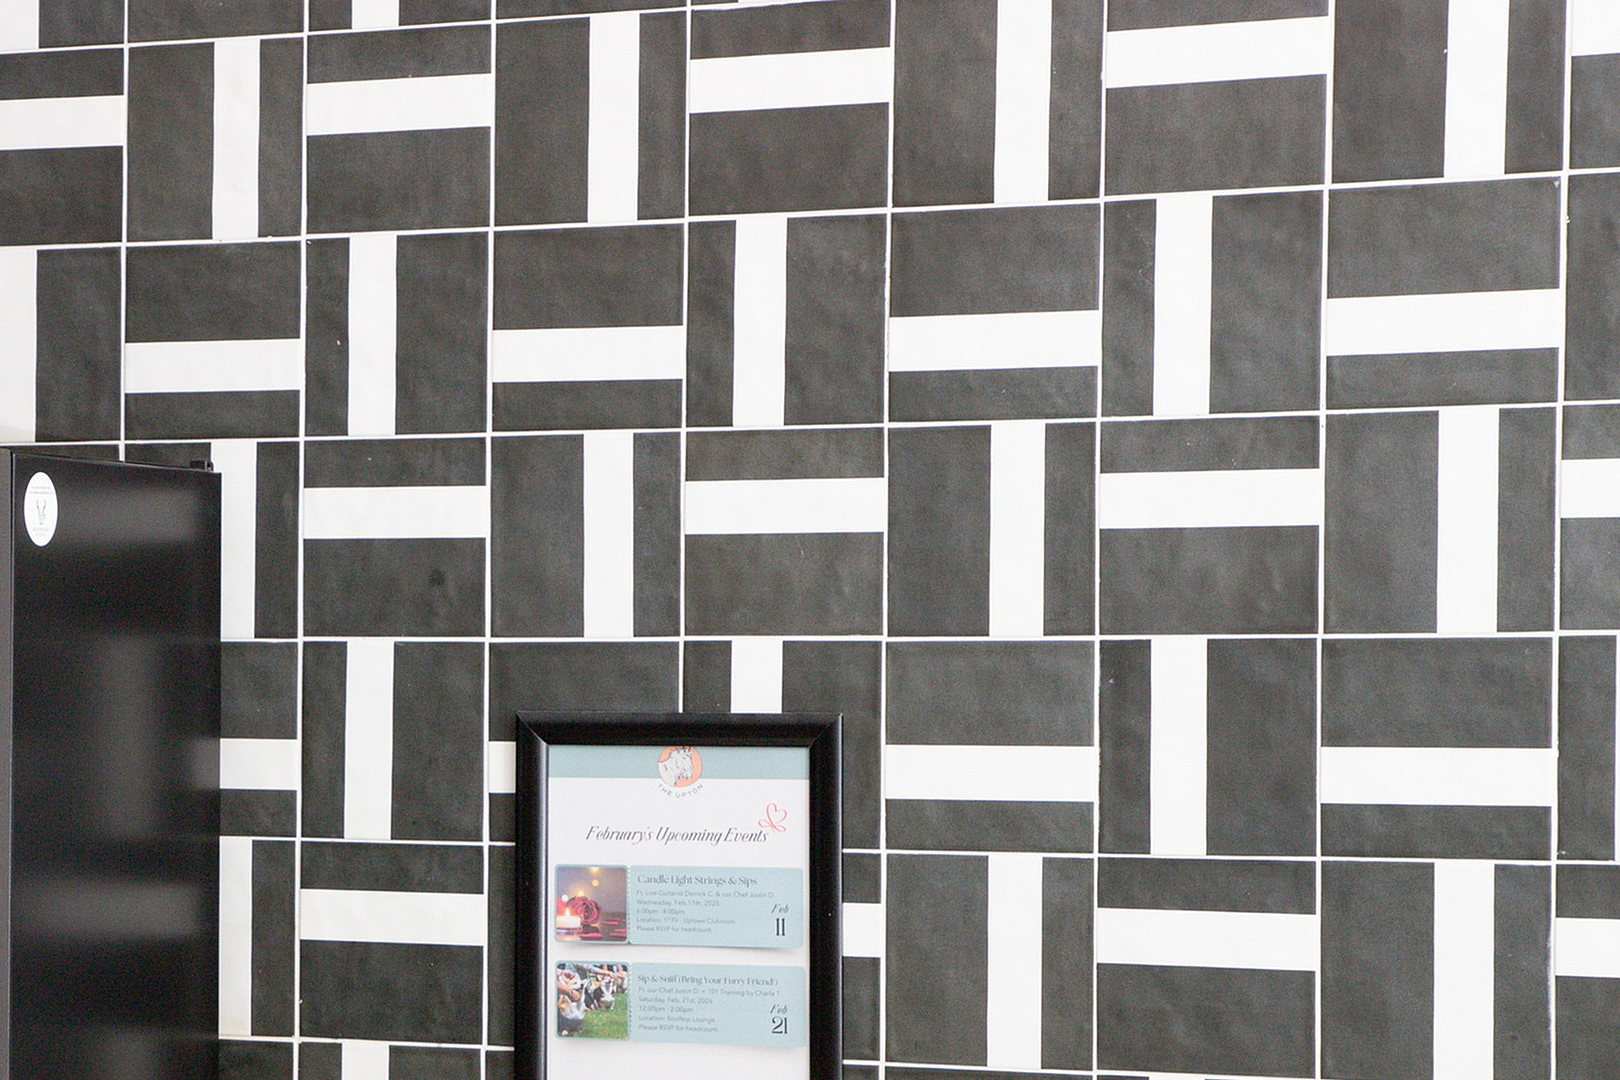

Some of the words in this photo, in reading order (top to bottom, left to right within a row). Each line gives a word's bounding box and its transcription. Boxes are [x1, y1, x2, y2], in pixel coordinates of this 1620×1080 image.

[658, 783, 672, 797] THE
[675, 783, 703, 799] UPTON
[586, 826, 654, 846] February's
[655, 827, 723, 846] Upcoming
[723, 827, 770, 844] Events
[637, 874, 670, 885] Candle
[670, 874, 693, 887] Light
[694, 875, 727, 888] Strings
[728, 876, 737, 886] &
[738, 876, 758, 889] Sips
[771, 903, 790, 914] Feb
[775, 917, 786, 937] 11
[637, 975, 650, 984] Sip
[703, 976, 723, 984] Your
[723, 976, 746, 987] Furry
[770, 1004, 788, 1015] Feb
[771, 1016, 788, 1035] 21
